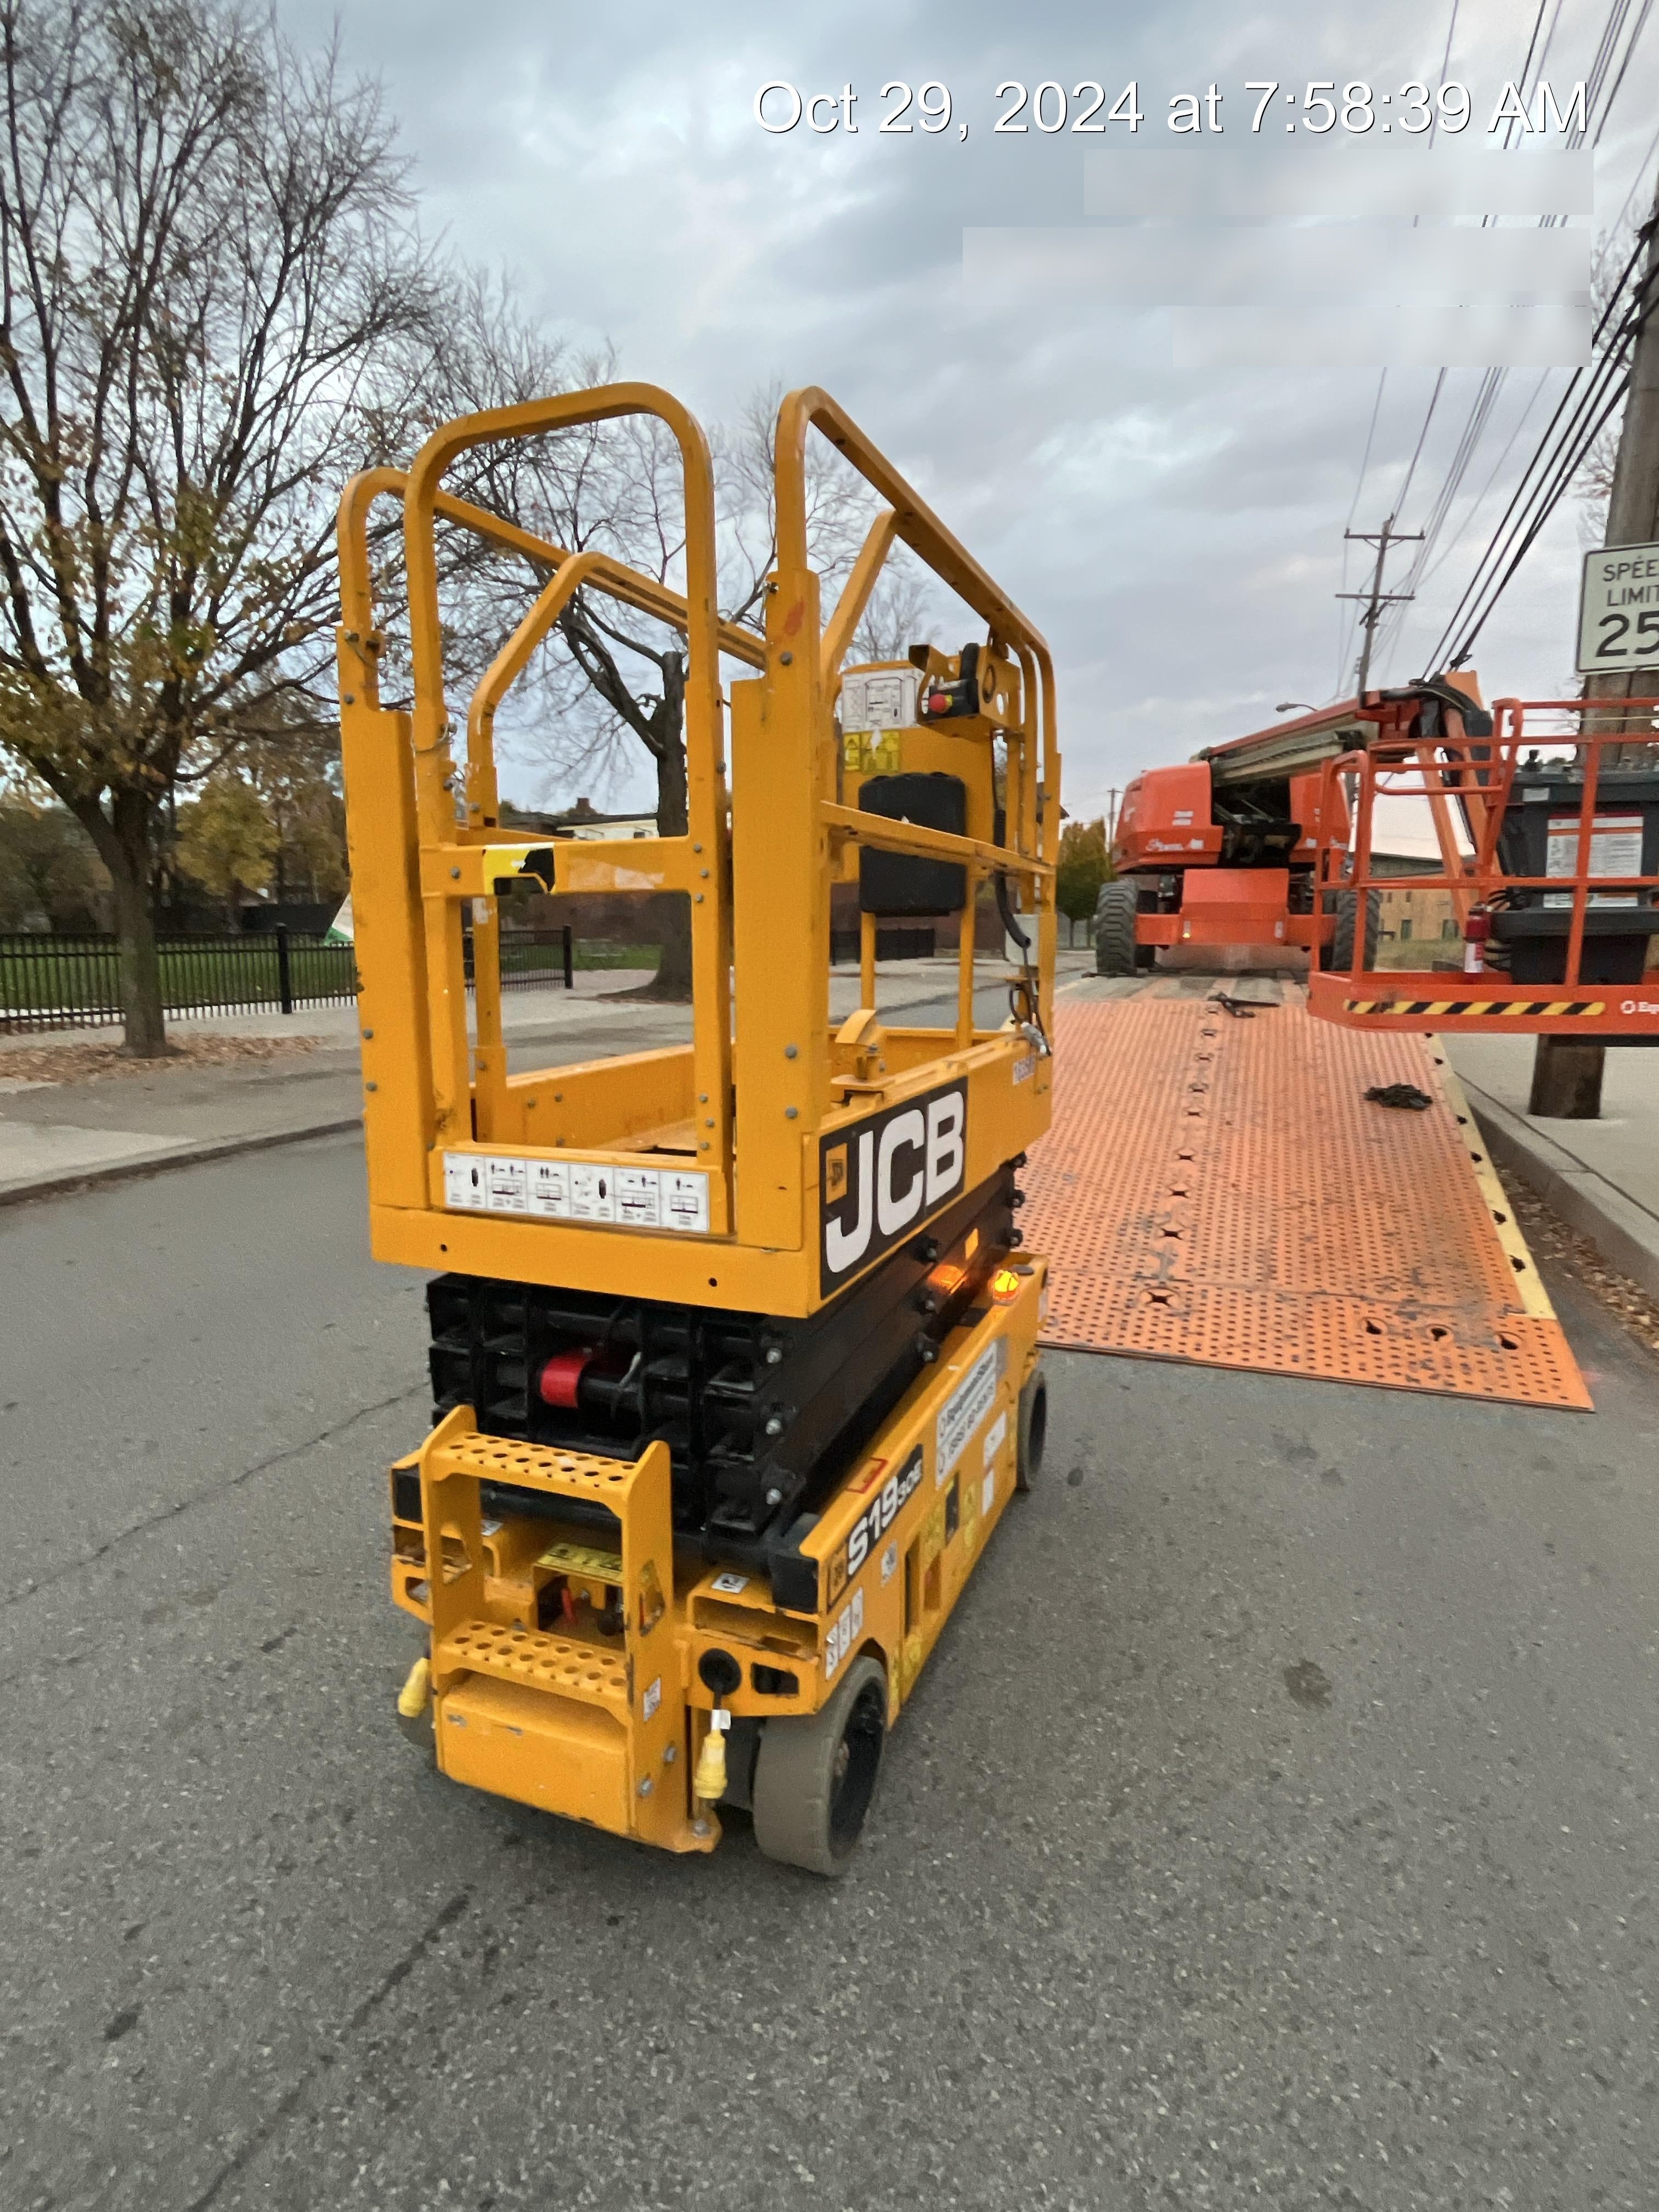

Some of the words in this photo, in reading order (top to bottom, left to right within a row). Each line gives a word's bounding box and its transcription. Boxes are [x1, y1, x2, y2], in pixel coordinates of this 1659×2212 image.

[1603, 558, 1659, 582] SPEE
[1595, 610, 1659, 658] 25
[826, 1091, 964, 1273] JCB
